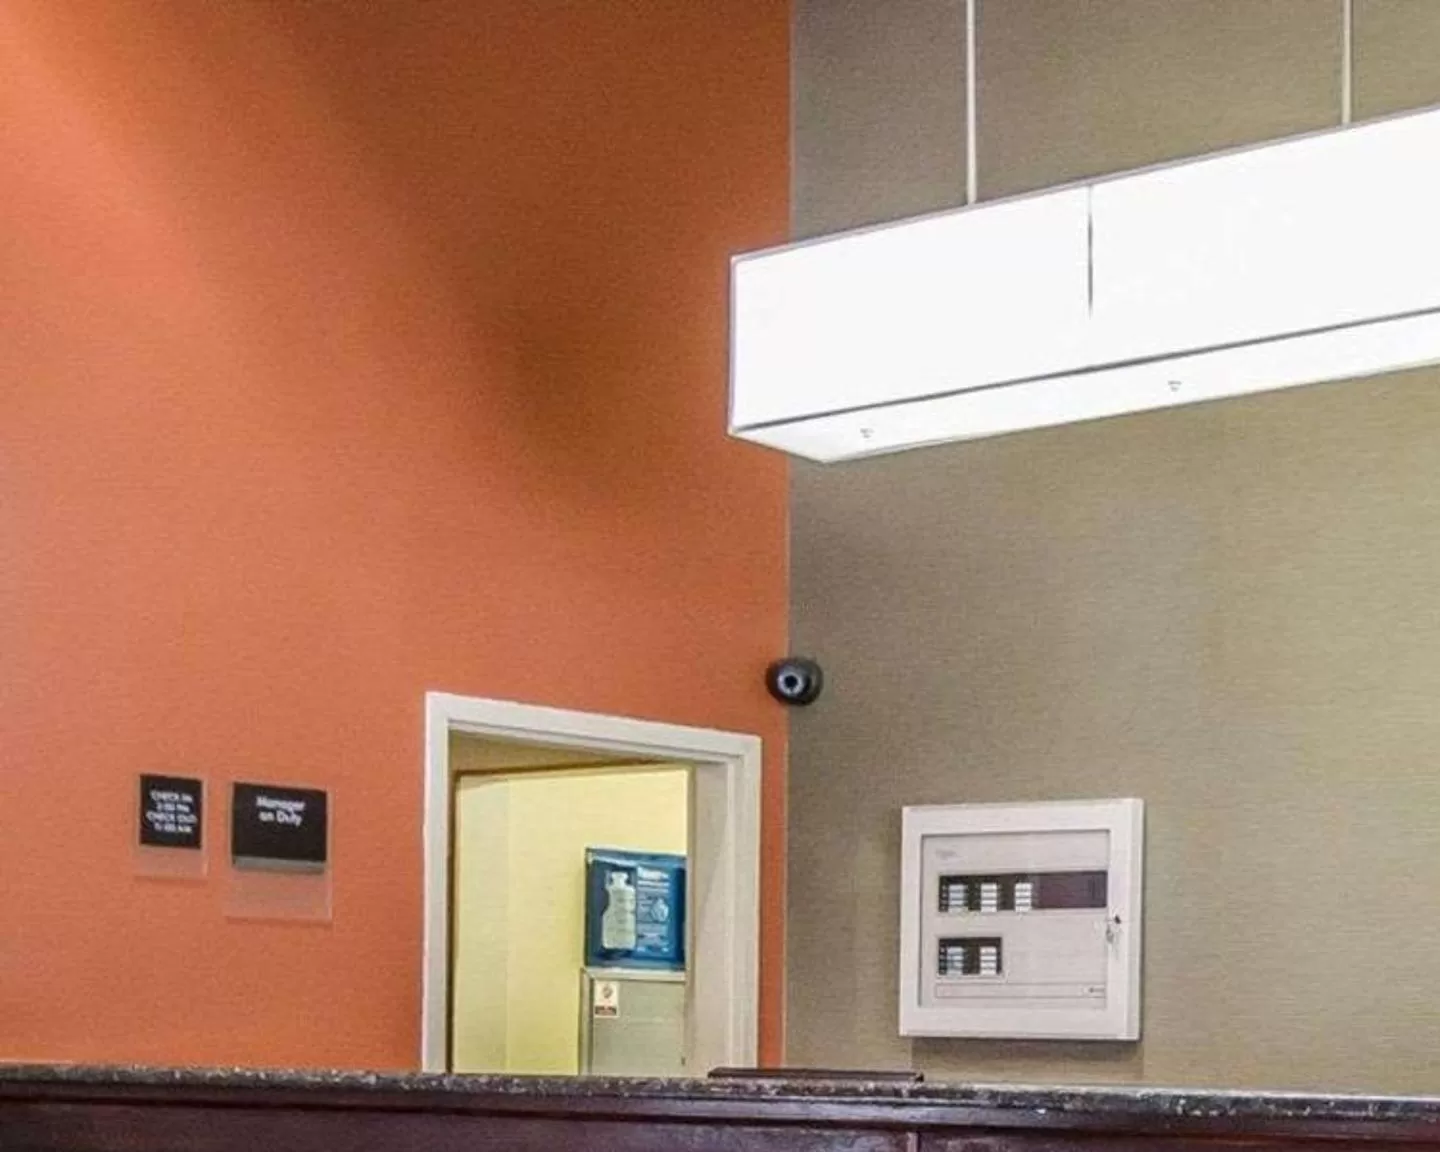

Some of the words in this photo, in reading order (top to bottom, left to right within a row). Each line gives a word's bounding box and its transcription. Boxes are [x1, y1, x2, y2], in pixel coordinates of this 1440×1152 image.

[256, 796, 305, 811] Manager
[259, 811, 275, 822] on
[276, 810, 302, 827] Duty
